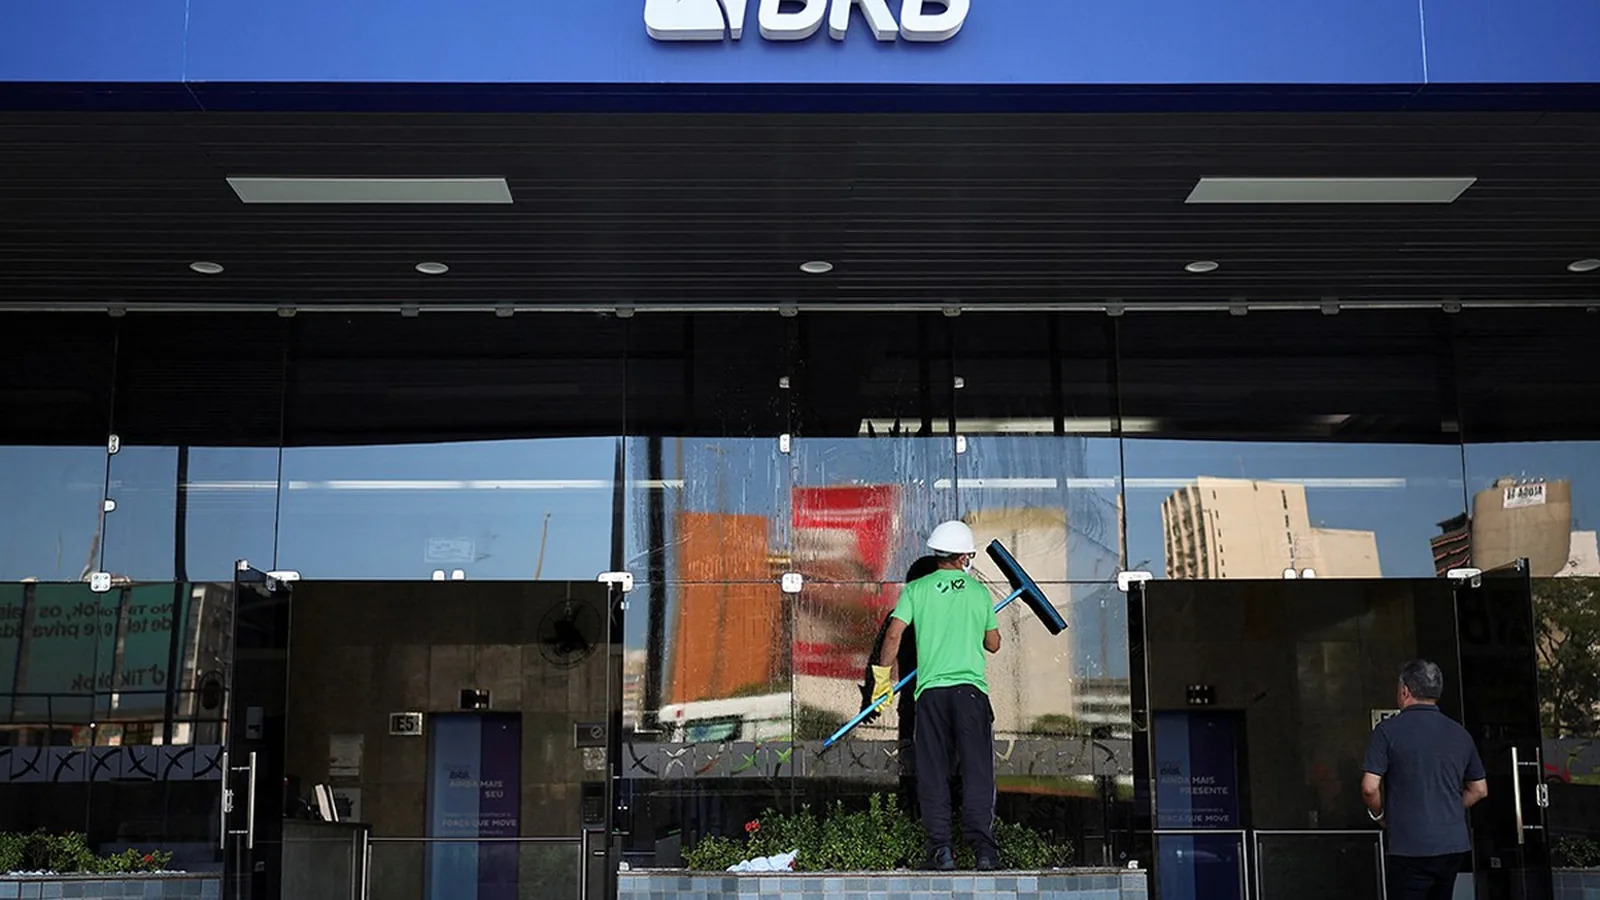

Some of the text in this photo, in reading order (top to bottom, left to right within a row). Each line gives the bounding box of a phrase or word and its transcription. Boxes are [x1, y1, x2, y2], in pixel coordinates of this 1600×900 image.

[950, 578, 965, 590] K2
[397, 716, 414, 731] E5
[479, 780, 504, 788] MAIS
[1191, 776, 1216, 785] MAIS
[484, 790, 504, 799] SEU
[1180, 786, 1229, 795] PRESENTE
[491, 818, 517, 828] MOVE
[1204, 814, 1230, 823] MOVE
